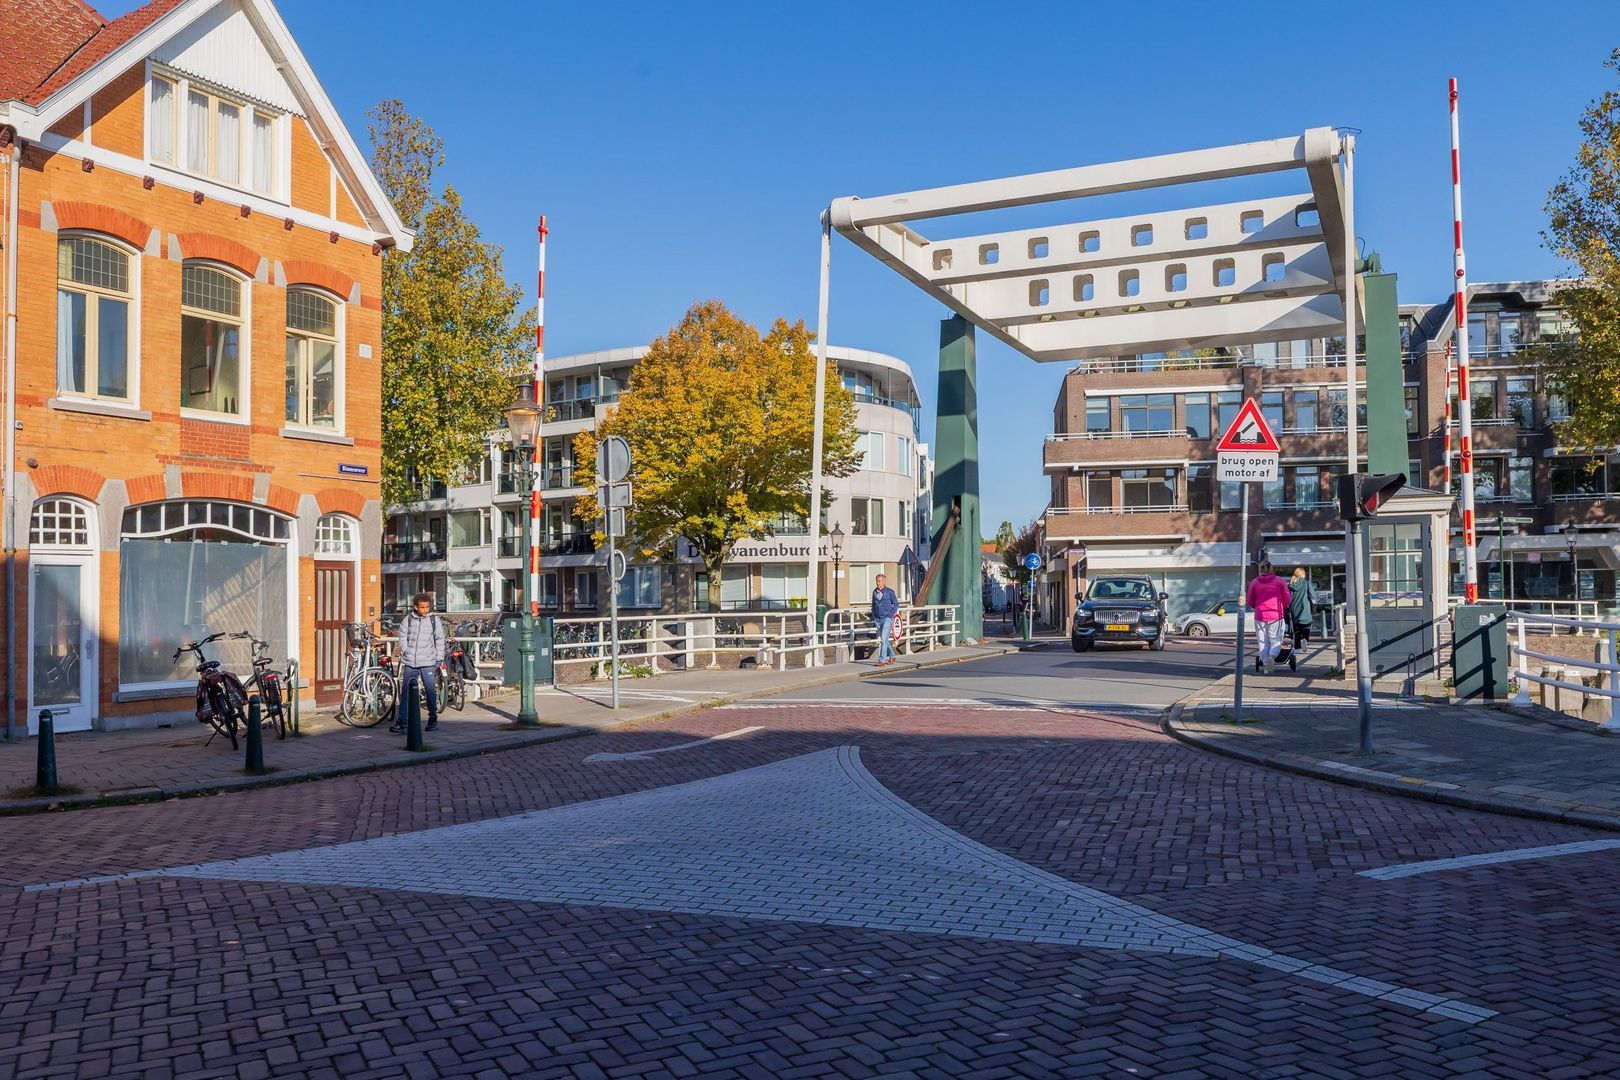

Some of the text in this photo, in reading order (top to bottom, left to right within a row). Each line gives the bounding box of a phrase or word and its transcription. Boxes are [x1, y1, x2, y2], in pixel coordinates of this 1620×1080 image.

[1222, 457, 1274, 467] brug open
[688, 545, 700, 558] D
